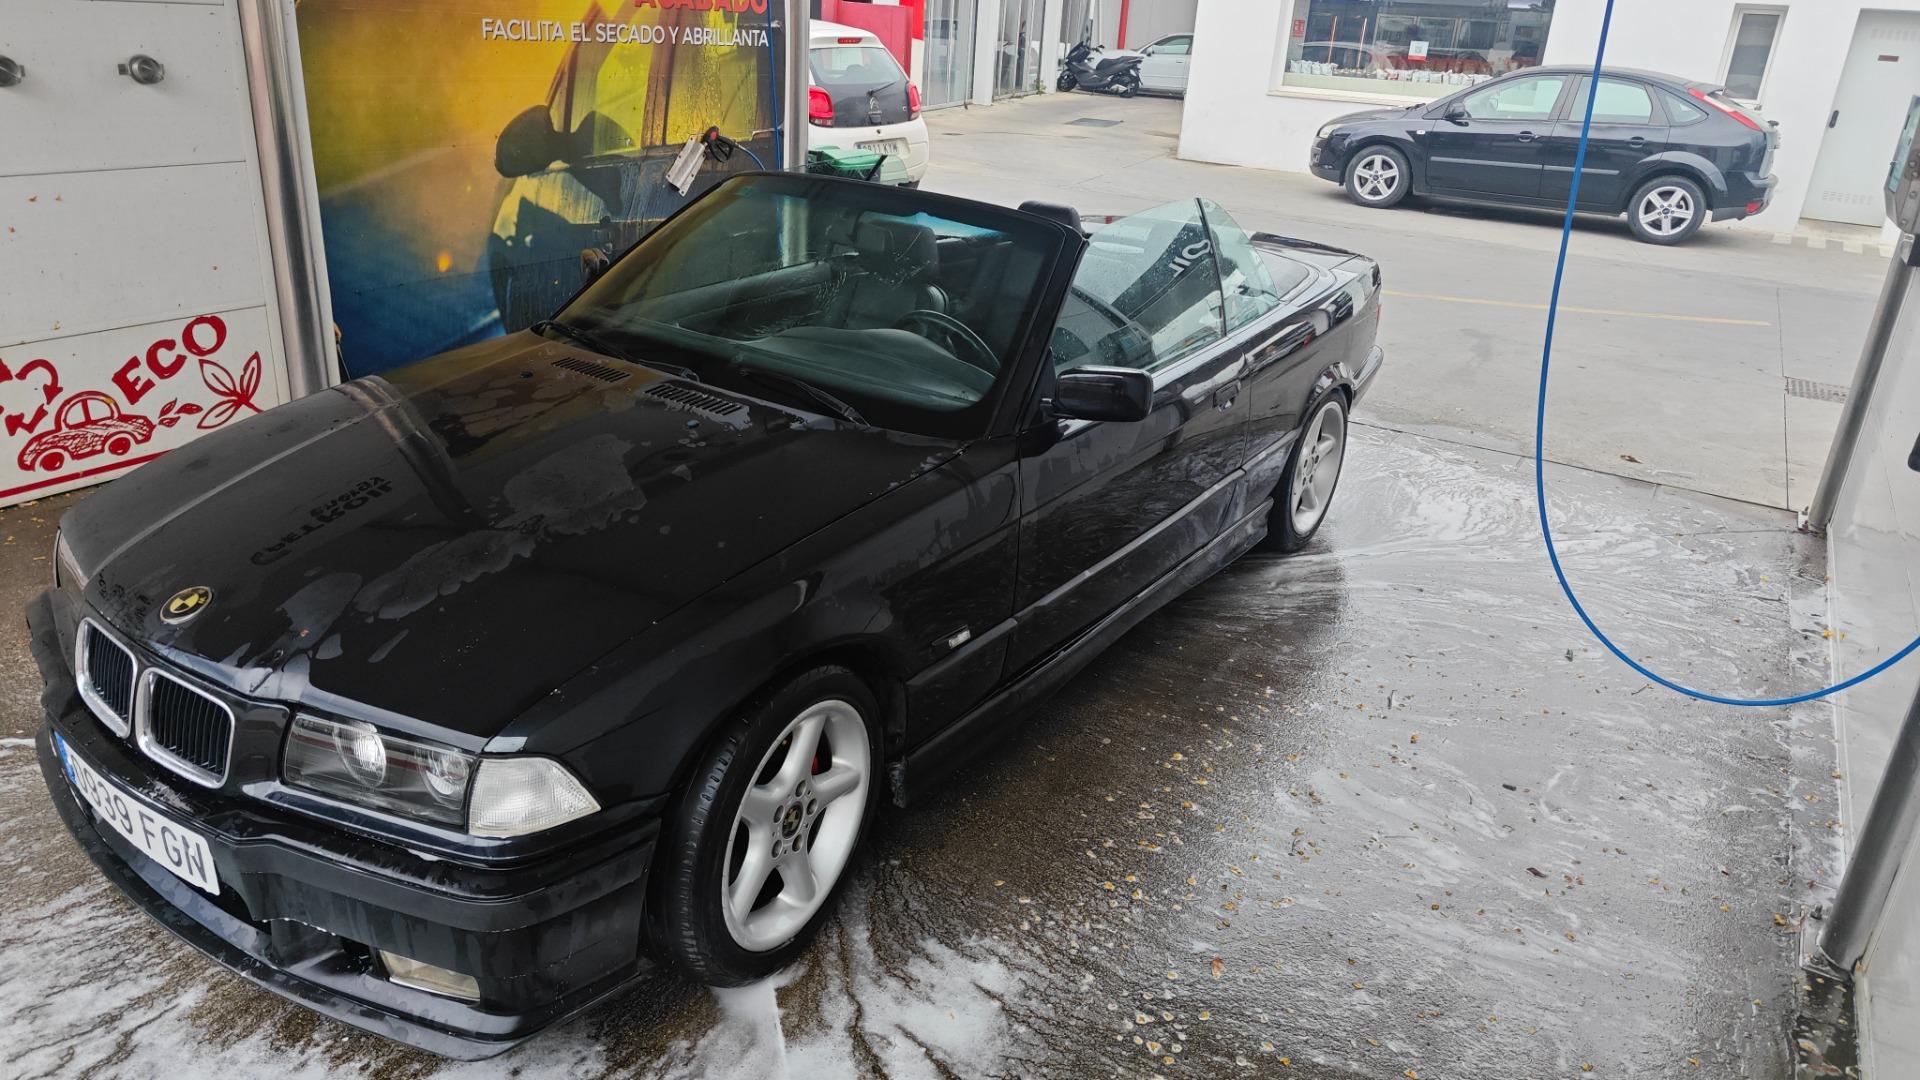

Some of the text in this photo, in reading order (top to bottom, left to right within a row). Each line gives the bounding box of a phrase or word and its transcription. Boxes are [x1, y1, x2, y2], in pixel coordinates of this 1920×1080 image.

[481, 18, 769, 47] FACILITA EL SECADO Y ABRILLANTA
[111, 315, 227, 405] ECO
[138, 810, 208, 884] FGN
